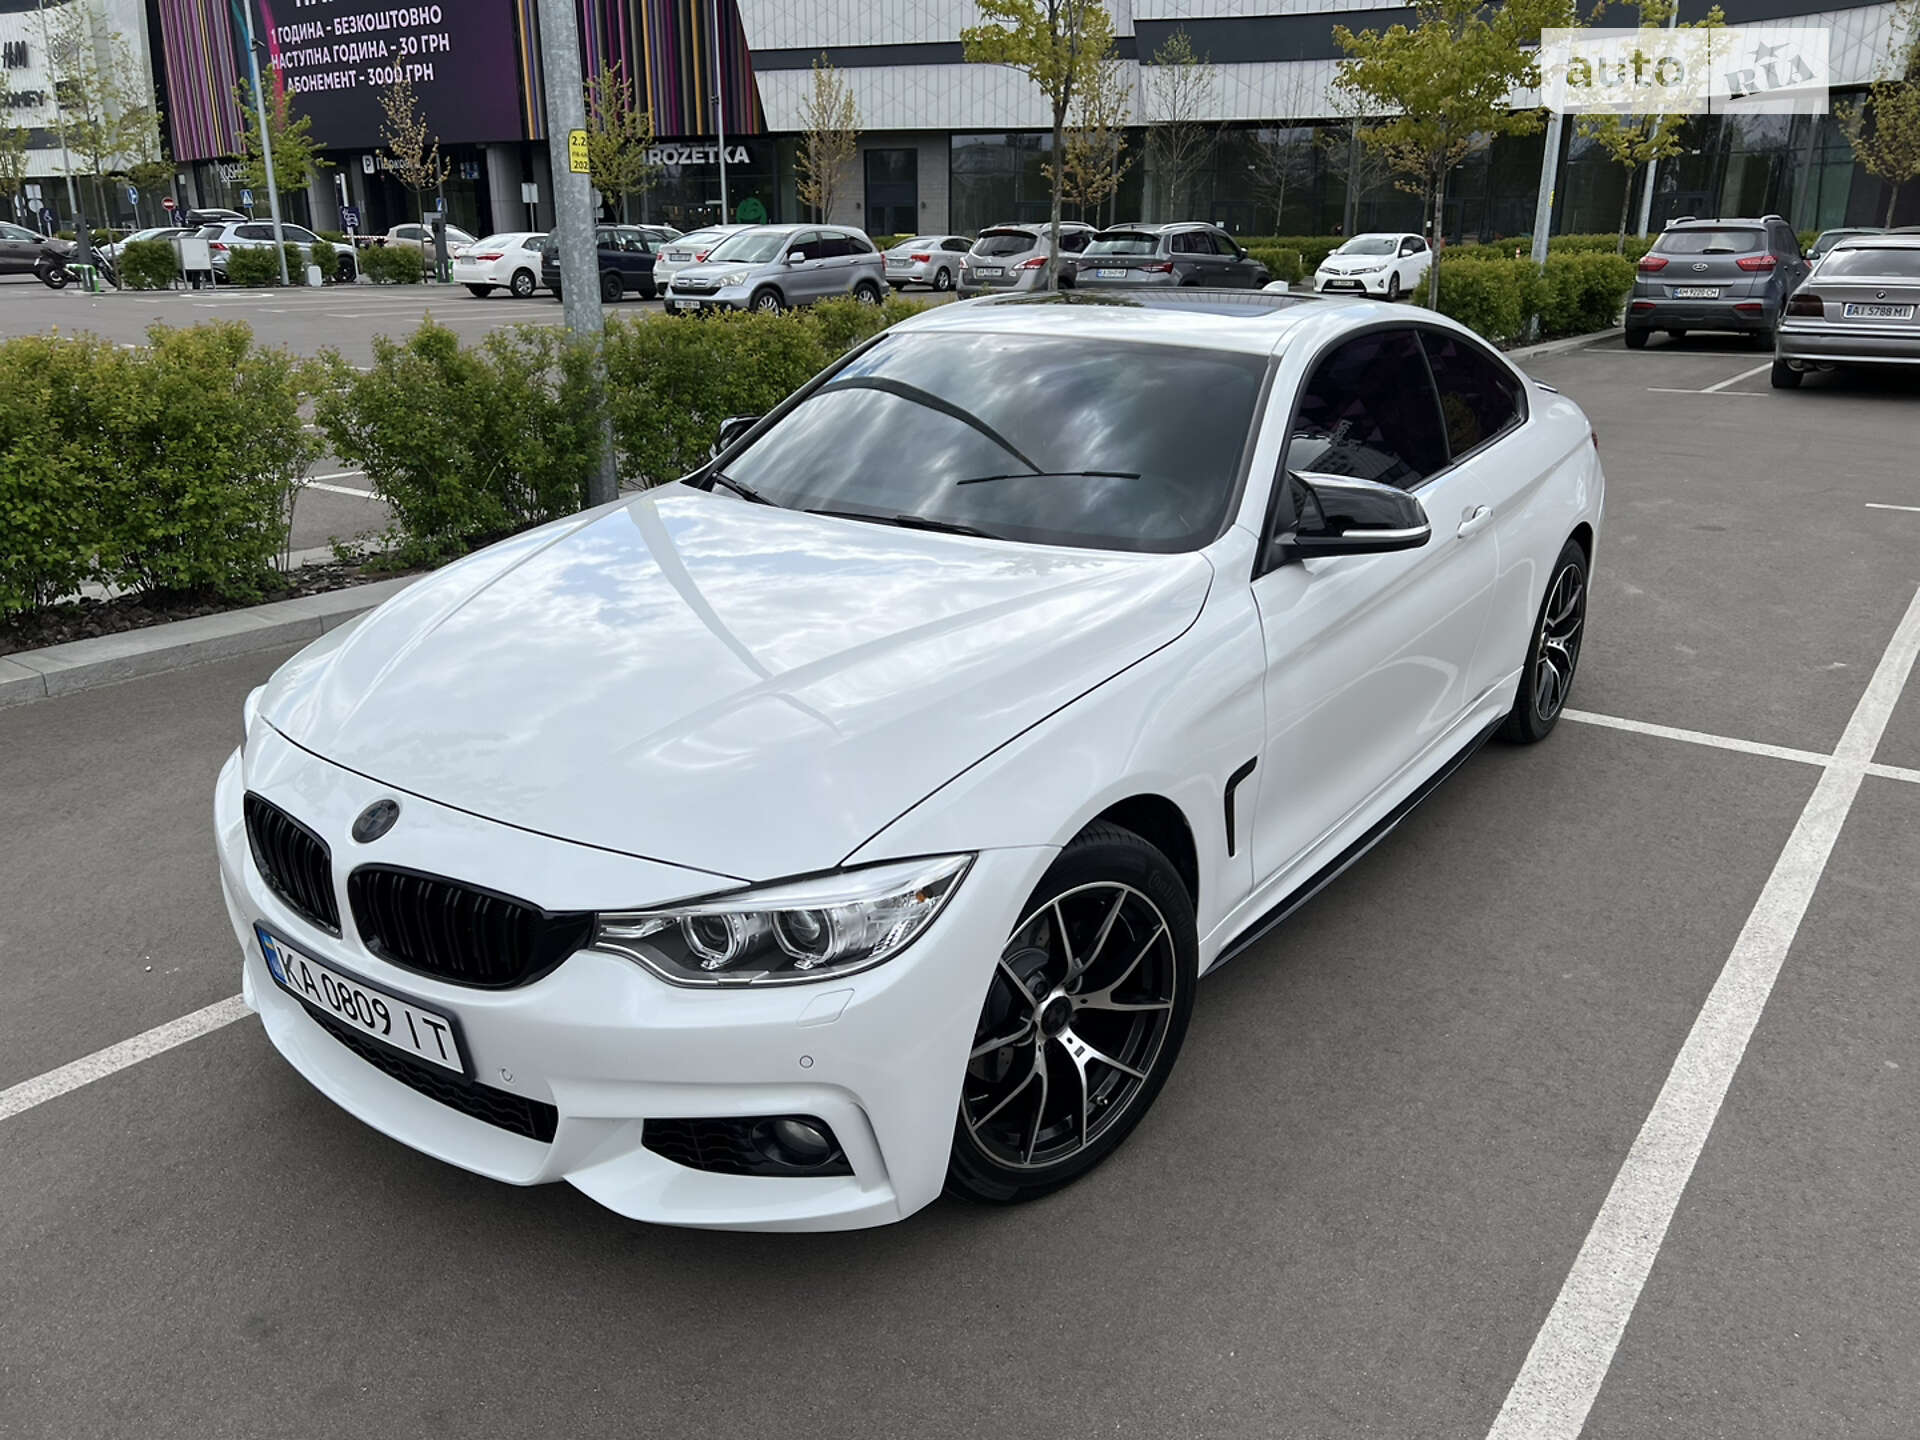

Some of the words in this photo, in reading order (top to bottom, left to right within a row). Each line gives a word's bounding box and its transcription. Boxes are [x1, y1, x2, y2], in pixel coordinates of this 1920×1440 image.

[271, 28, 277, 44] 1
[278, 21, 324, 46] ГОДИНА
[334, 5, 442, 36] БЕЗКОШТОВНО
[272, 47, 331, 70] НАСТУПНА
[333, 40, 388, 64] ГОДИНА
[400, 36, 418, 55] 30
[421, 33, 450, 53] ГРН
[287, 70, 356, 93] АБОНЕМЕНТ
[368, 66, 404, 86] 3000
[406, 63, 434, 83] ГРН
[649, 145, 750, 165] ROZETKA
[276, 946, 322, 1002] KA
[322, 973, 392, 1036] 0809
[405, 1010, 447, 1060] IT
